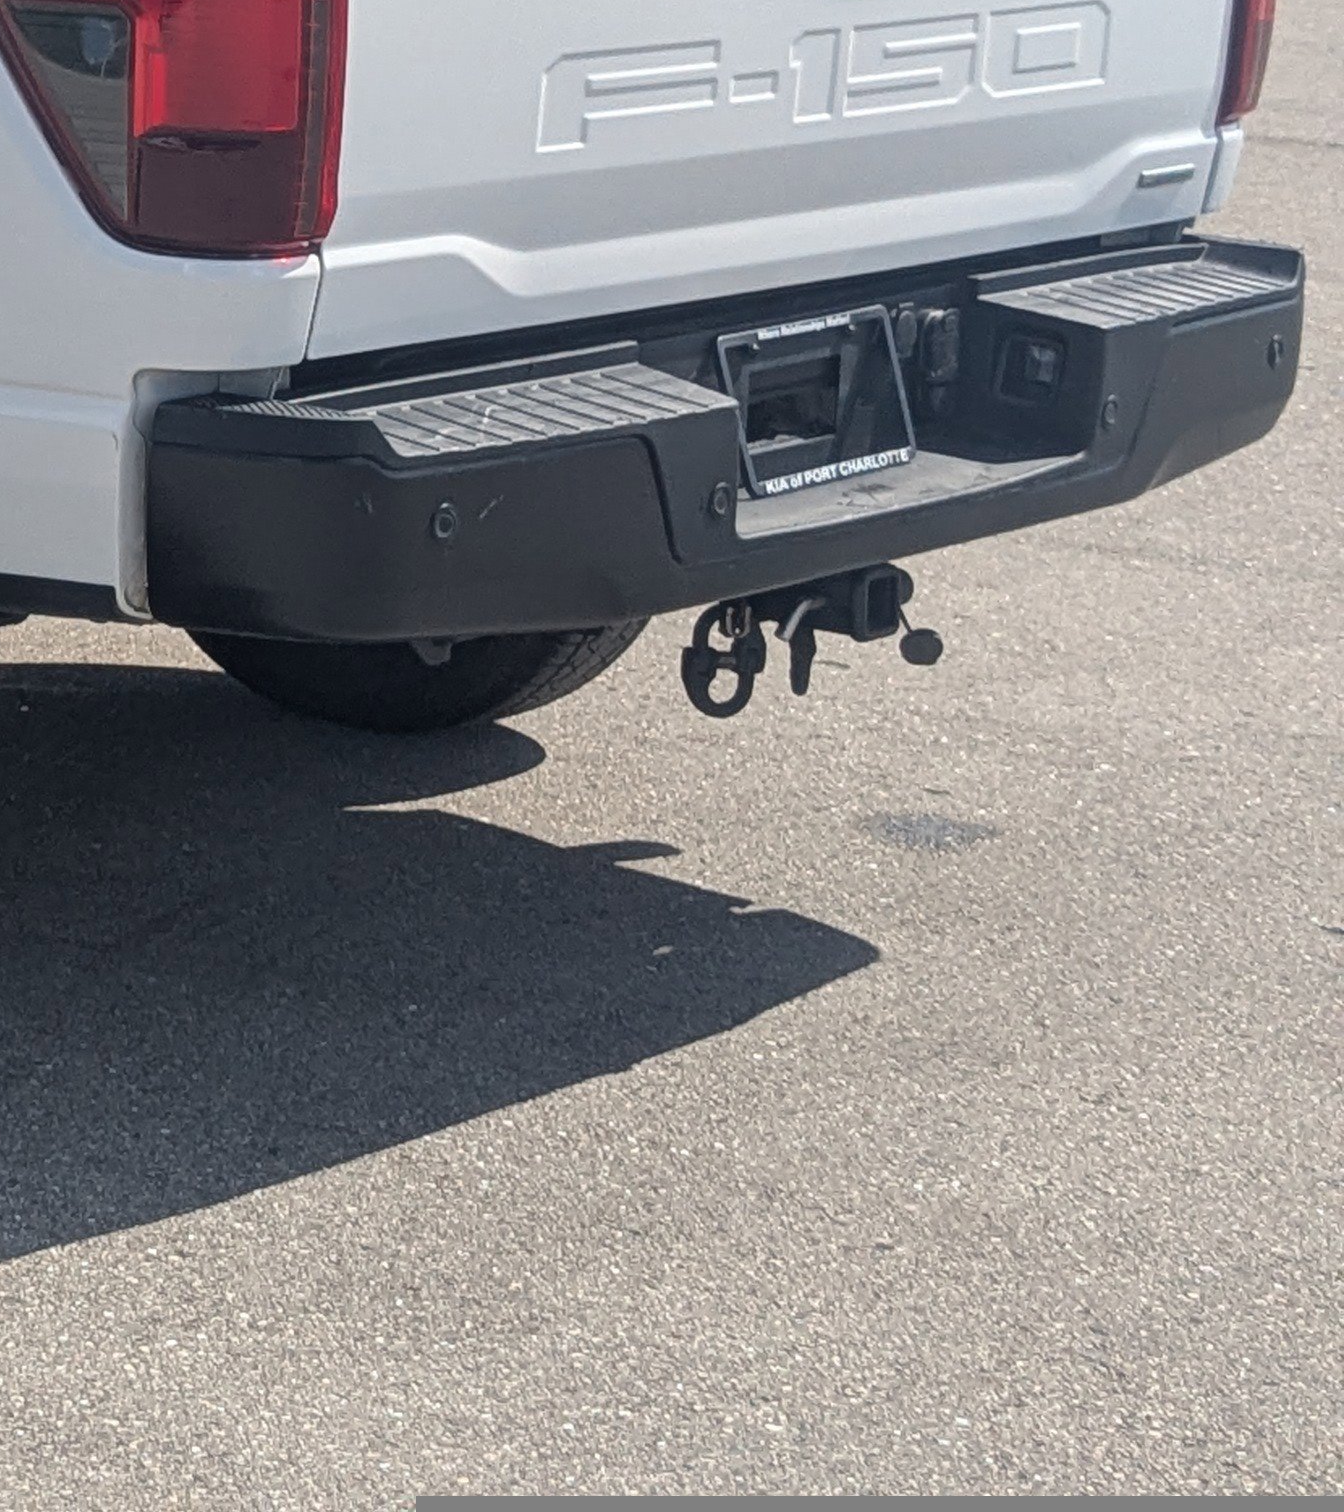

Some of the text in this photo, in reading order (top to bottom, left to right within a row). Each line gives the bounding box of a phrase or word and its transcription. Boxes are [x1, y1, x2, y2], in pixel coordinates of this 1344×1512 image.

[765, 448, 910, 495] KIA of PORT CHARLOTTE
